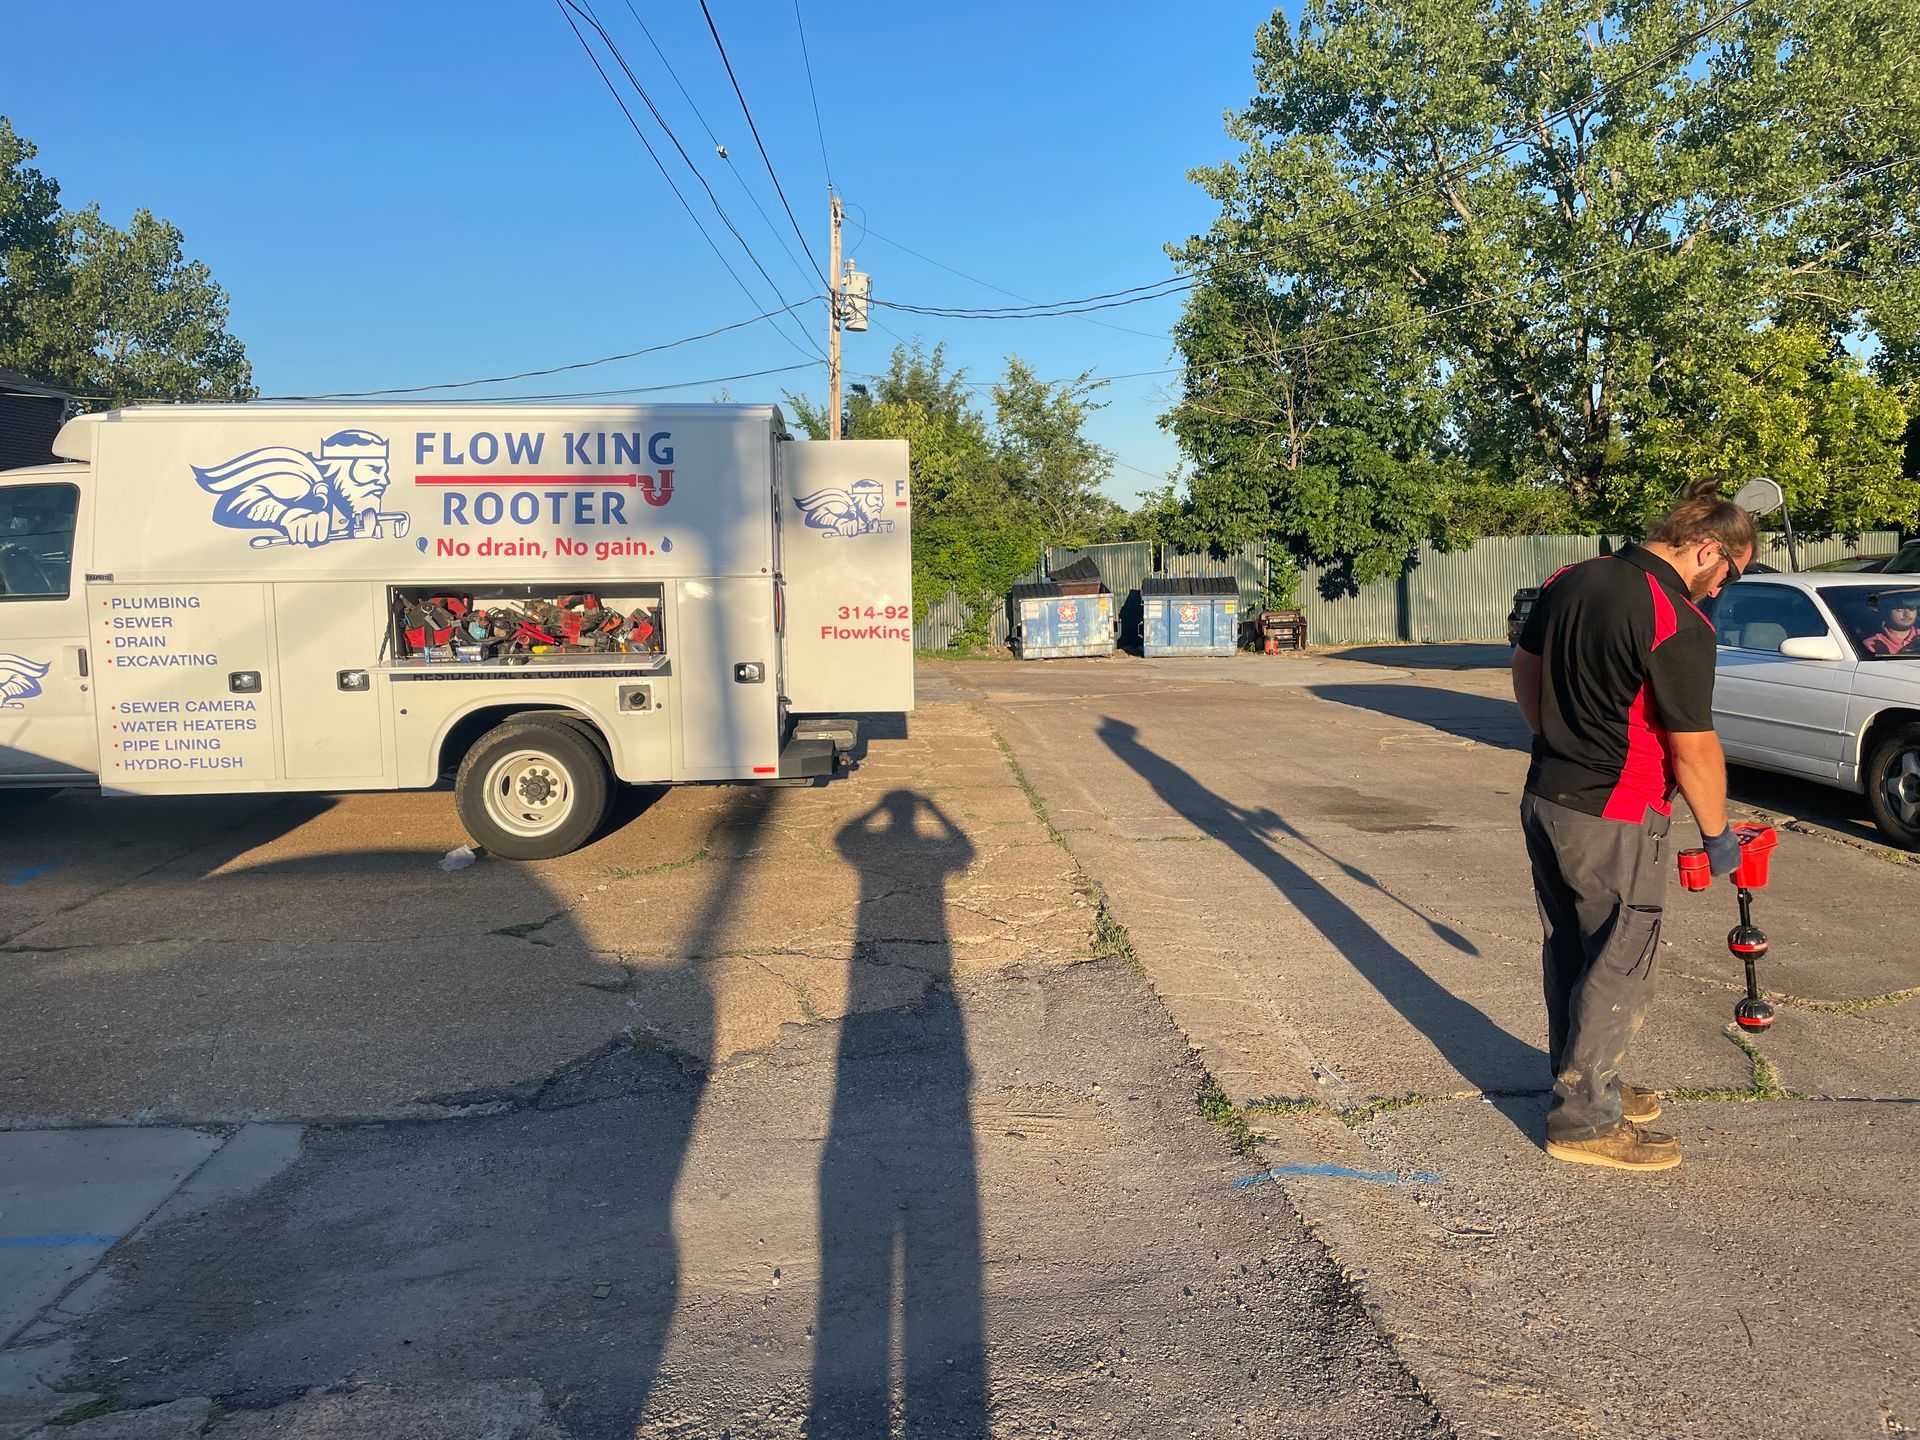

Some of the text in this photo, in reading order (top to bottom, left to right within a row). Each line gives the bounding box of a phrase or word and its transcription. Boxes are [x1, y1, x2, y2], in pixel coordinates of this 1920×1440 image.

[415, 431, 675, 465] FLOW KING
[443, 491, 628, 526] ROOTER
[436, 536, 655, 561] No drain, No gain.
[111, 597, 201, 609] PLUMBING
[838, 605, 909, 620] 314-92
[113, 616, 173, 629] SEWER
[114, 636, 166, 648] DRAIN
[116, 654, 218, 667] EXCAVATING
[120, 700, 256, 714] SEWER CAMERA
[121, 719, 257, 732] WATER HEATERS
[123, 738, 221, 752] PIPE LINING
[124, 757, 243, 770] HYDRO-FLUSH
